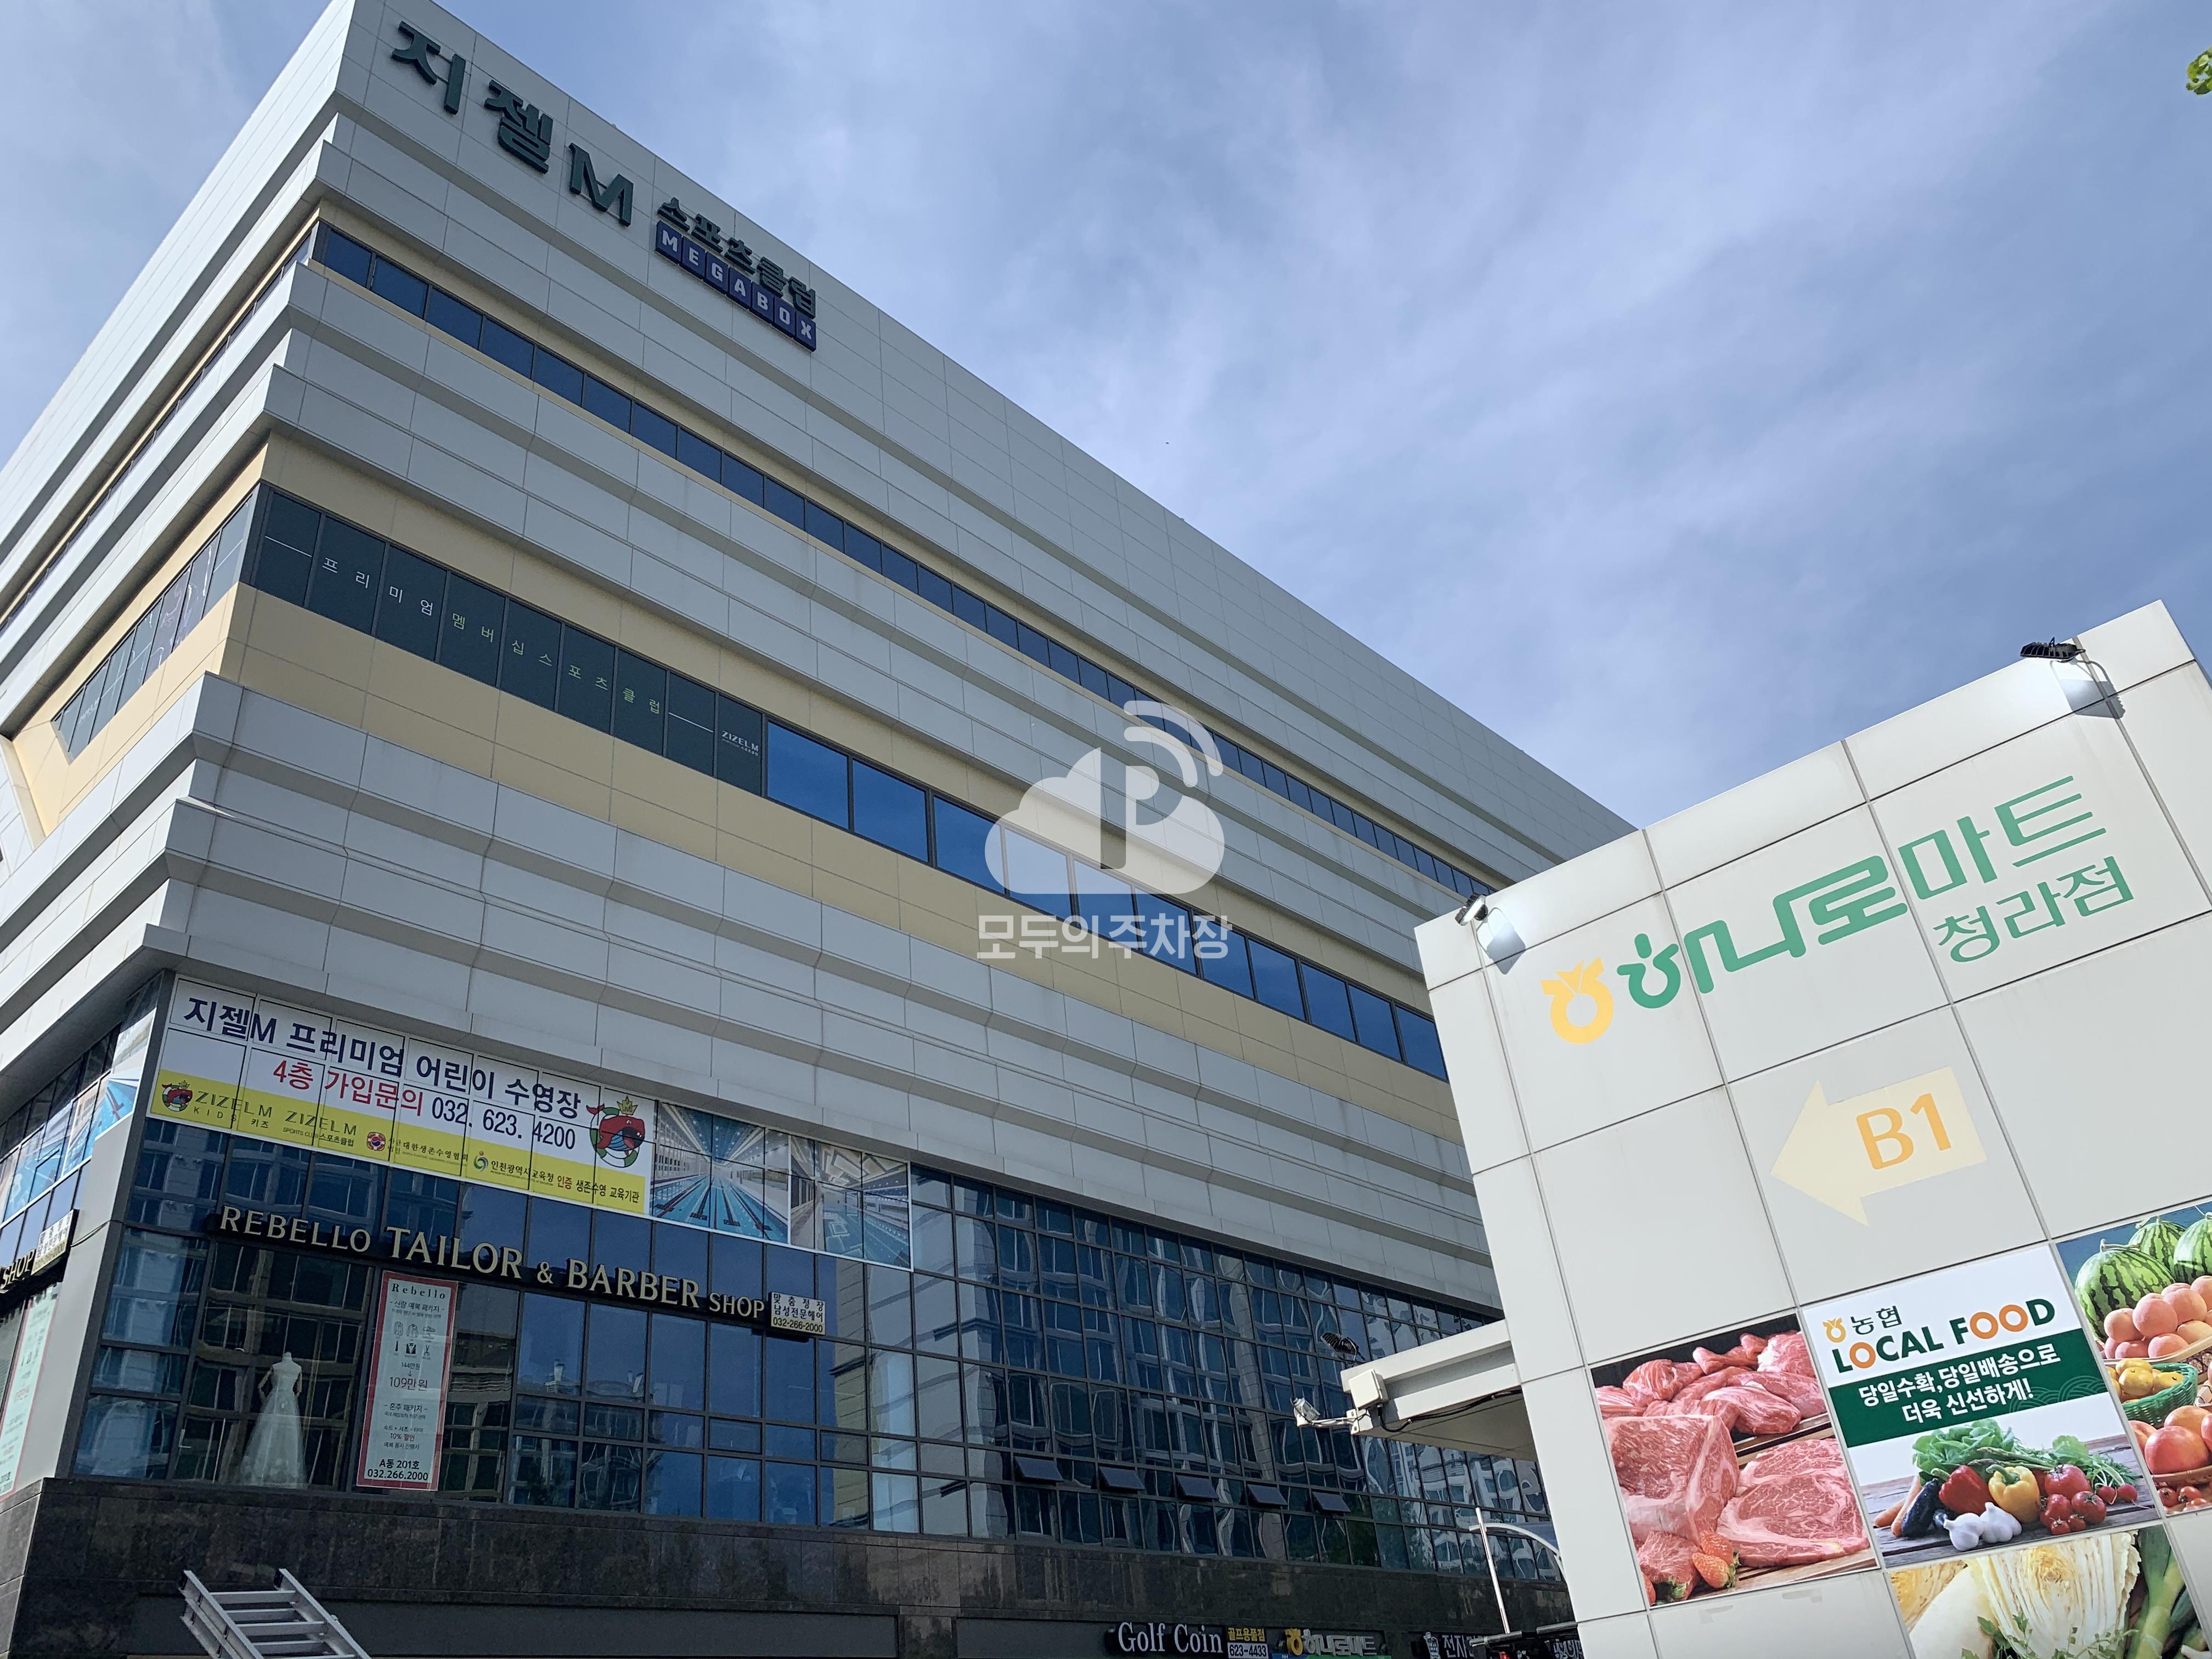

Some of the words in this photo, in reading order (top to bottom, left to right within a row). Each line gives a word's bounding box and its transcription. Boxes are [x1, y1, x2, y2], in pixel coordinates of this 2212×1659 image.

[391, 20, 634, 227] 지젤M
[657, 198, 816, 319] 스포츠클럽
[661, 227, 814, 341] MEGABOX
[722, 730, 758, 752] ZIZELM
[1617, 775, 2107, 1009] 하나로마트
[1933, 856, 2135, 963] 청라점
[184, 996, 276, 1043] 지젤M
[285, 1021, 404, 1078] 프리미엄
[416, 1054, 494, 1099] 어린이
[504, 1077, 581, 1120] 수영장
[194, 1107, 237, 1122] KIDS
[251, 1119, 268, 1128] 키즈
[195, 1091, 272, 1118] ZIZELM
[273, 1060, 313, 1090] 4층
[324, 1069, 423, 1116] 가입문의
[533, 1121, 575, 1149] 4200
[285, 1110, 357, 1136] ZIZELM
[319, 1132, 355, 1147] 스포츠클럽
[1856, 1092, 1951, 1170] B1
[491, 1160, 554, 1182] 인천광역시교육청
[557, 1175, 572, 1190] 인증
[575, 1180, 607, 1197] 생존수영
[610, 1187, 640, 1204] 교육기관
[219, 1205, 371, 1253] REBELLO
[386, 1226, 522, 1279] TAILOR
[537, 1261, 554, 1283] &
[567, 1258, 700, 1309] BARBER
[709, 1292, 765, 1319] SHOP
[391, 1283, 445, 1300] Rebello
[773, 1317, 823, 1333] 032-266-2000
[1832, 1326, 1944, 1374] LOCAL
[1951, 1298, 2056, 1345] FOOD
[1849, 1305, 1903, 1335] 농협
[390, 1376, 428, 1392] 109만원
[1902, 1400, 1943, 1425] 더욱
[1946, 1377, 2034, 1417] 신선하게!
[367, 1468, 429, 1481] 032.266.2000
[379, 1458, 394, 1469] A동
[396, 1460, 420, 1470] 201호
[1118, 1621, 1166, 1652] Golf
[1173, 1623, 1224, 1654] Coin
[1229, 1644, 1267, 1657] 623-4433
